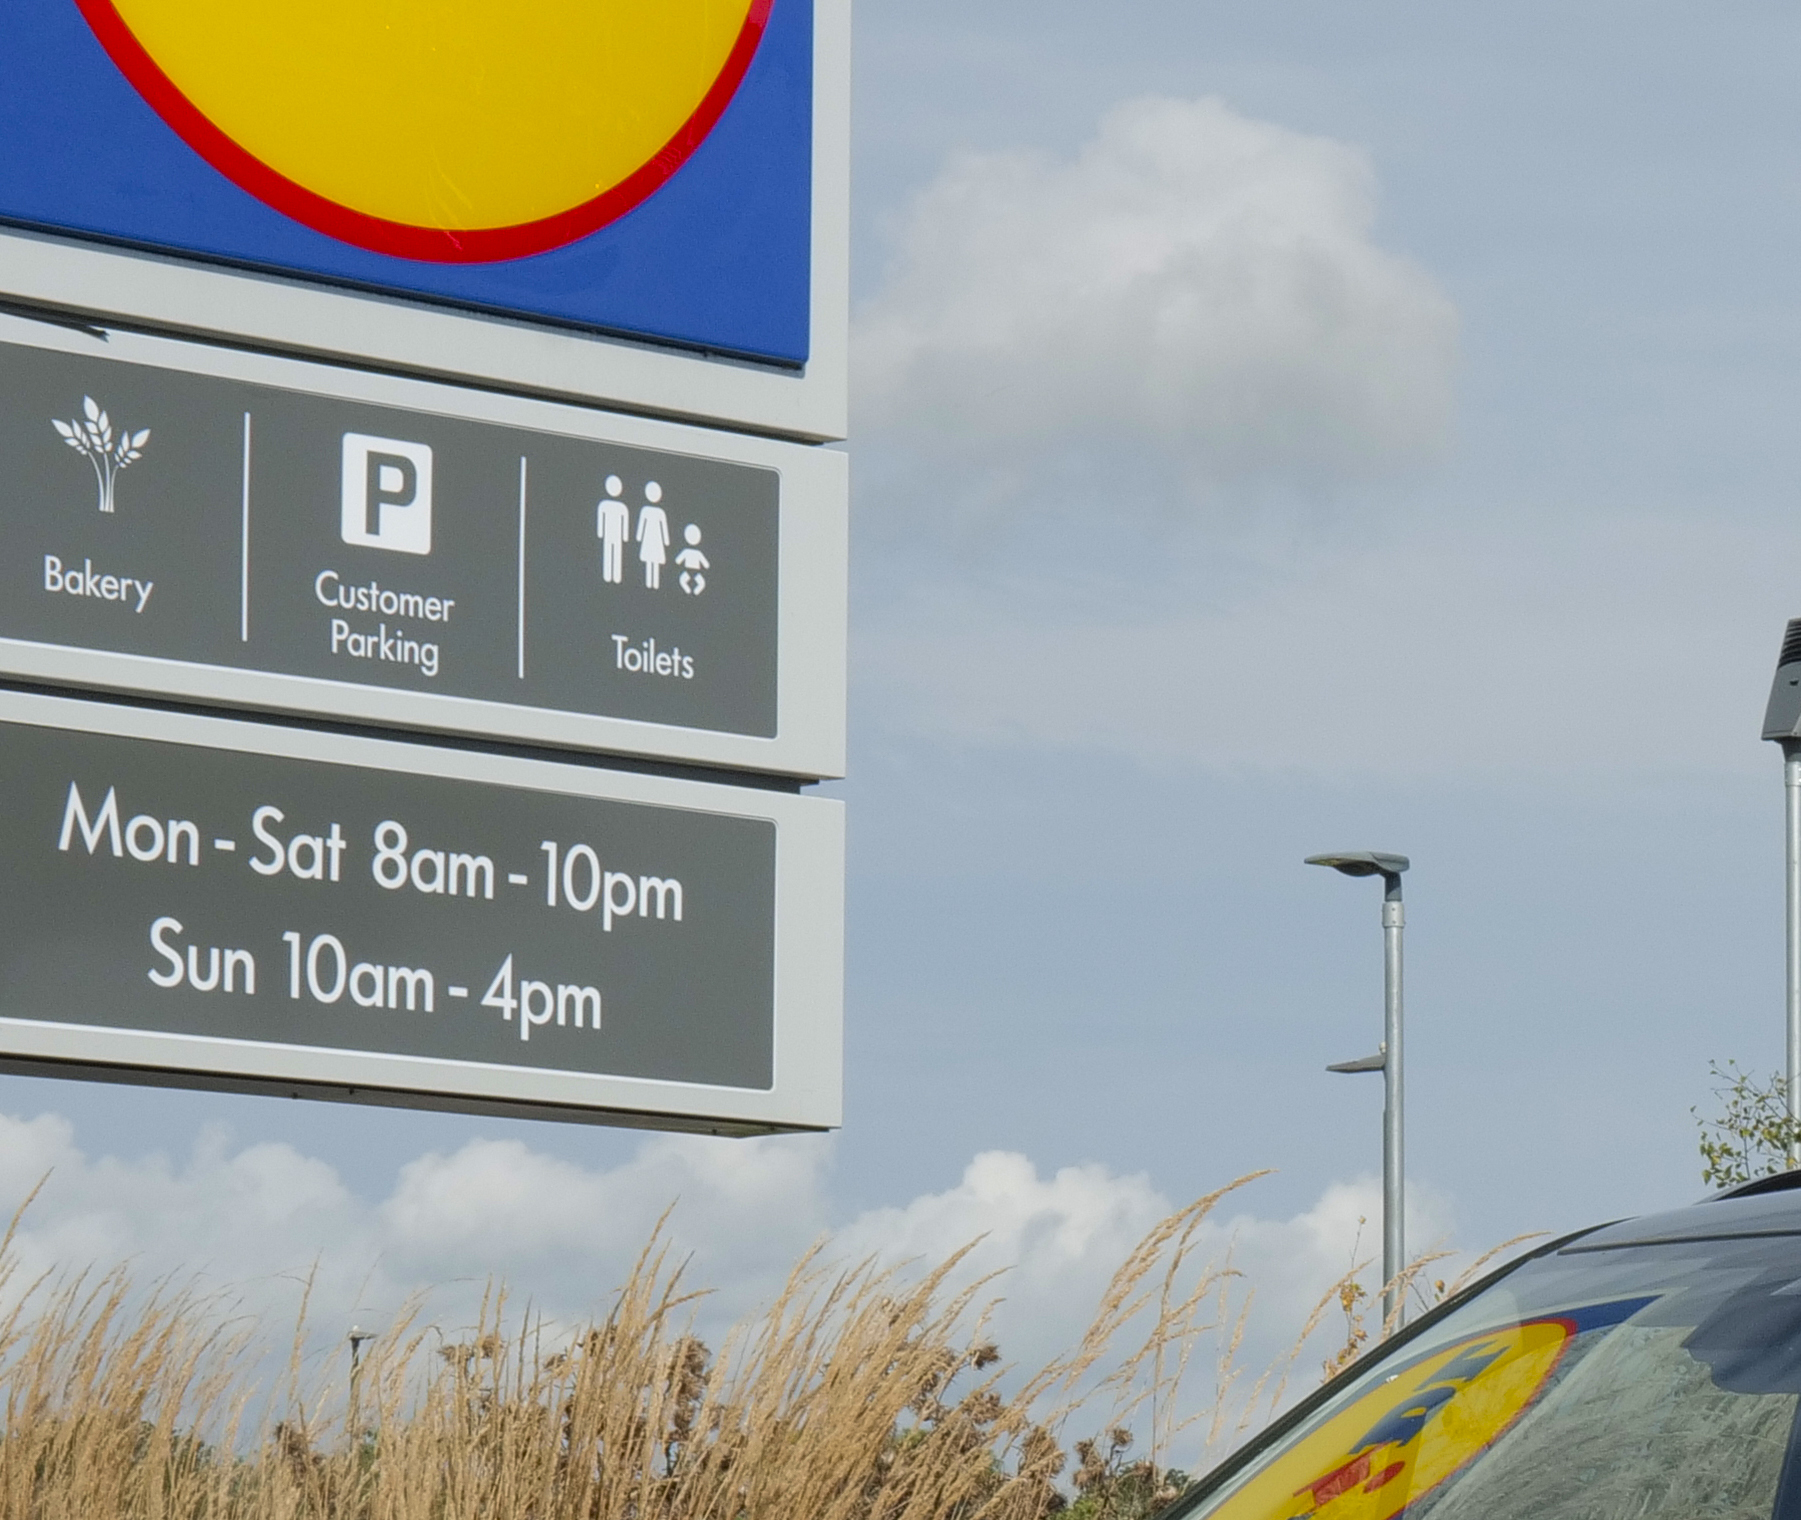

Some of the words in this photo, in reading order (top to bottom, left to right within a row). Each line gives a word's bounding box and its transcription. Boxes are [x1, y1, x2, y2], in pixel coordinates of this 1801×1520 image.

[44, 554, 153, 614] Bakery
[314, 569, 455, 623] Customer
[330, 619, 440, 677] Parking
[611, 634, 696, 680] Toilets
[58, 780, 200, 866] Mon
[250, 804, 346, 883] Sat
[372, 820, 495, 900] 8am
[540, 840, 684, 933] 10pm
[147, 916, 256, 995] Sun
[282, 931, 434, 1013] 10am
[481, 952, 602, 1042] 4pm
